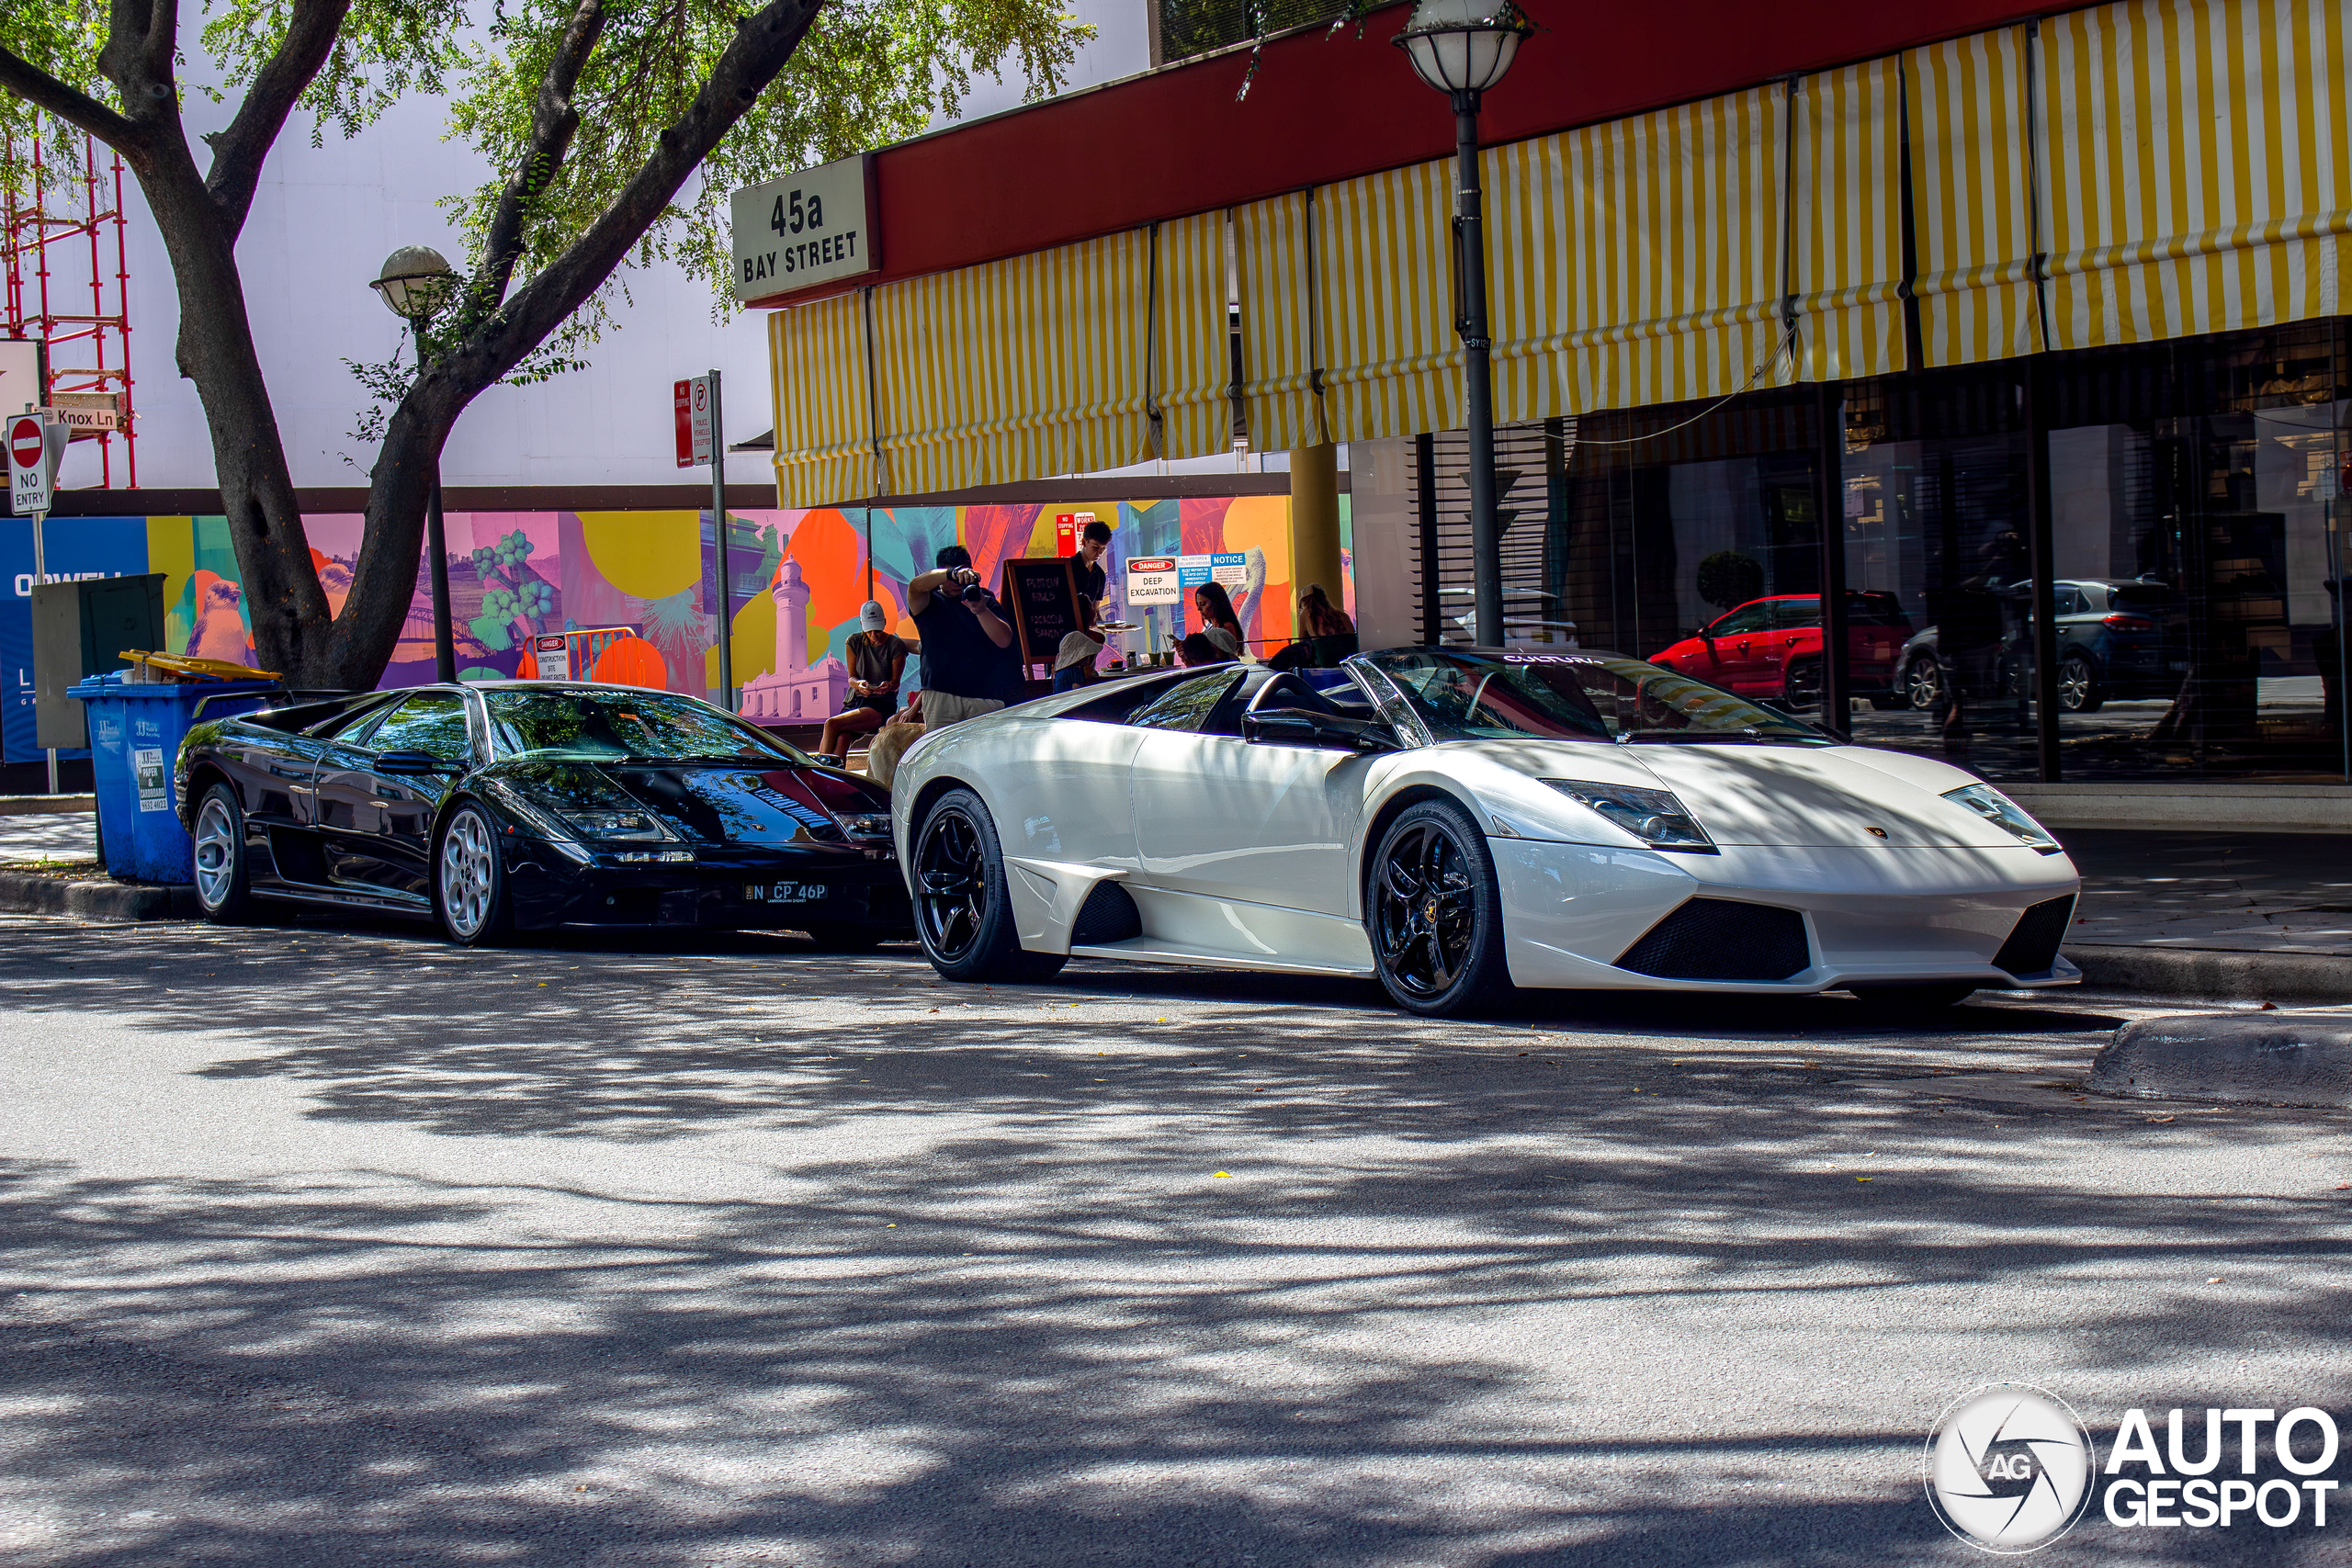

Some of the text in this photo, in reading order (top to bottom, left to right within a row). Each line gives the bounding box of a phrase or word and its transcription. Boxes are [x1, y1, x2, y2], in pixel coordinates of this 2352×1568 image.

[771, 189, 823, 238] 45a
[743, 231, 856, 283] BAY STREET
[679, 386, 685, 395] NO
[676, 397, 690, 408] STOPPING
[58, 410, 113, 426] Knox Ln
[695, 418, 708, 427] POLICE
[694, 428, 710, 437] VEHICLES
[20, 473, 38, 489] NO
[16, 491, 45, 506] ENTRY
[1213, 555, 1243, 564] NOTICE
[1143, 577, 1163, 586] DEEP
[1130, 587, 1176, 597] EXCAVATION
[541, 640, 558, 648] DANGER
[538, 655, 566, 663] CONSTRUCTION
[143, 767, 158, 777] PAPER
[148, 778, 154, 787] &
[140, 787, 165, 799] CARDBOARD
[798, 885, 825, 899] 46P
